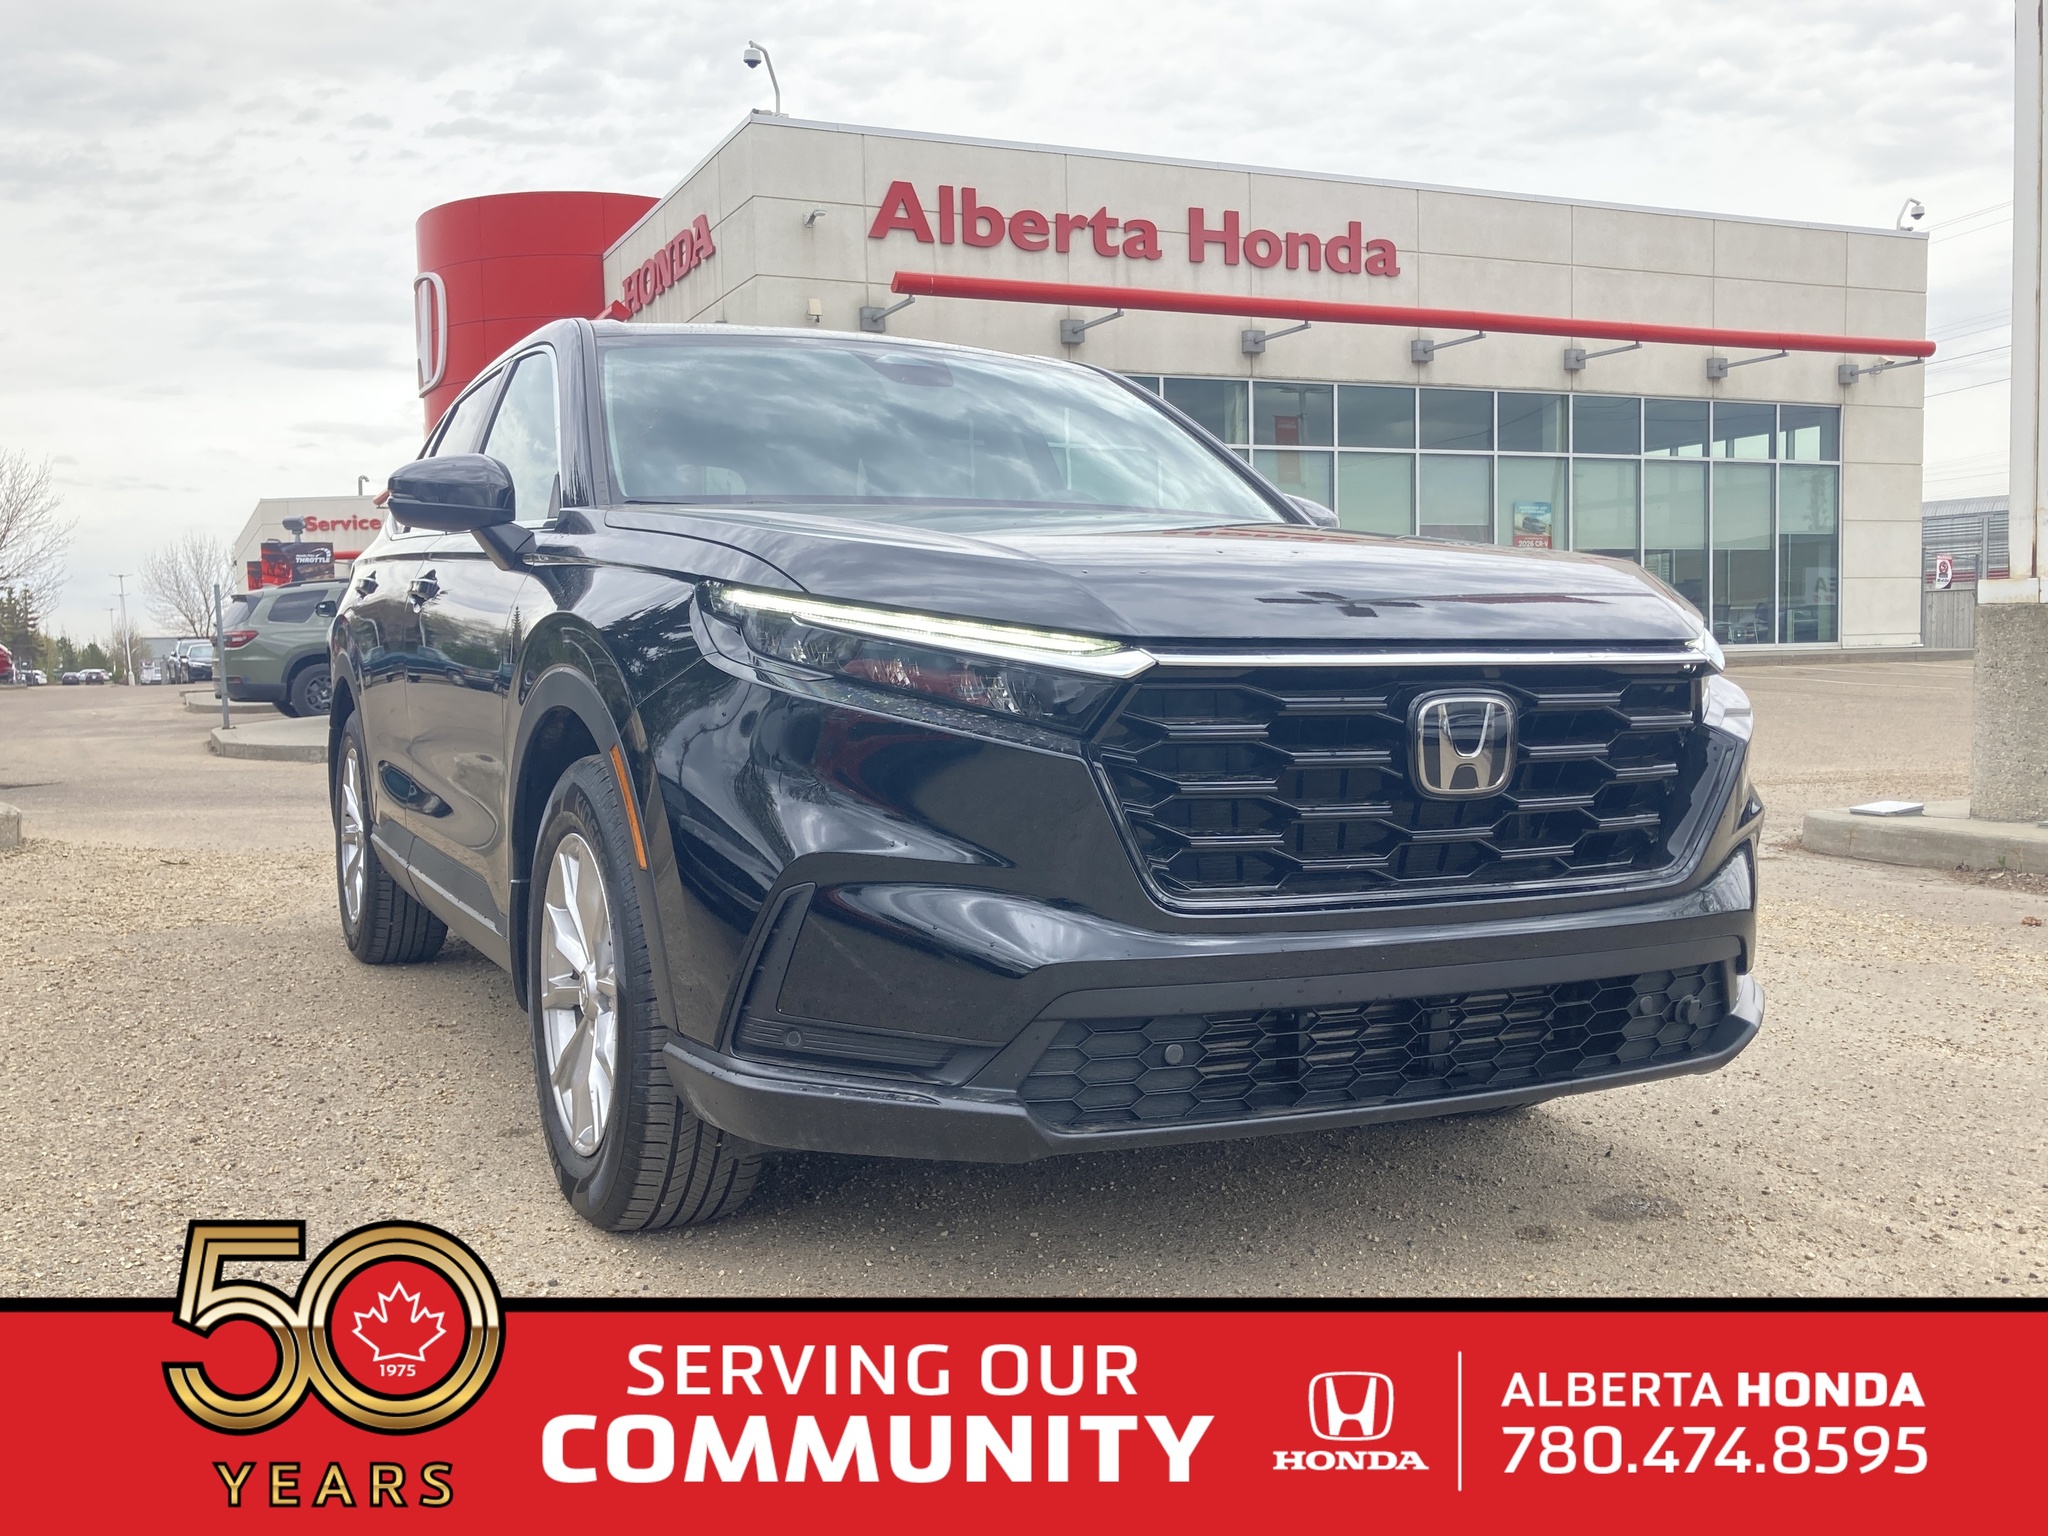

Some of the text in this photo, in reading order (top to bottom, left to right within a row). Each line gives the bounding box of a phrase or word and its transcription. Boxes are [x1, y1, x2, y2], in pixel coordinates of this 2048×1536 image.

[869, 180, 1400, 277] Alberta Honda
[621, 213, 717, 316] HONDA
[305, 515, 382, 532] Service
[1518, 540, 1549, 548] 2026 CR-V
